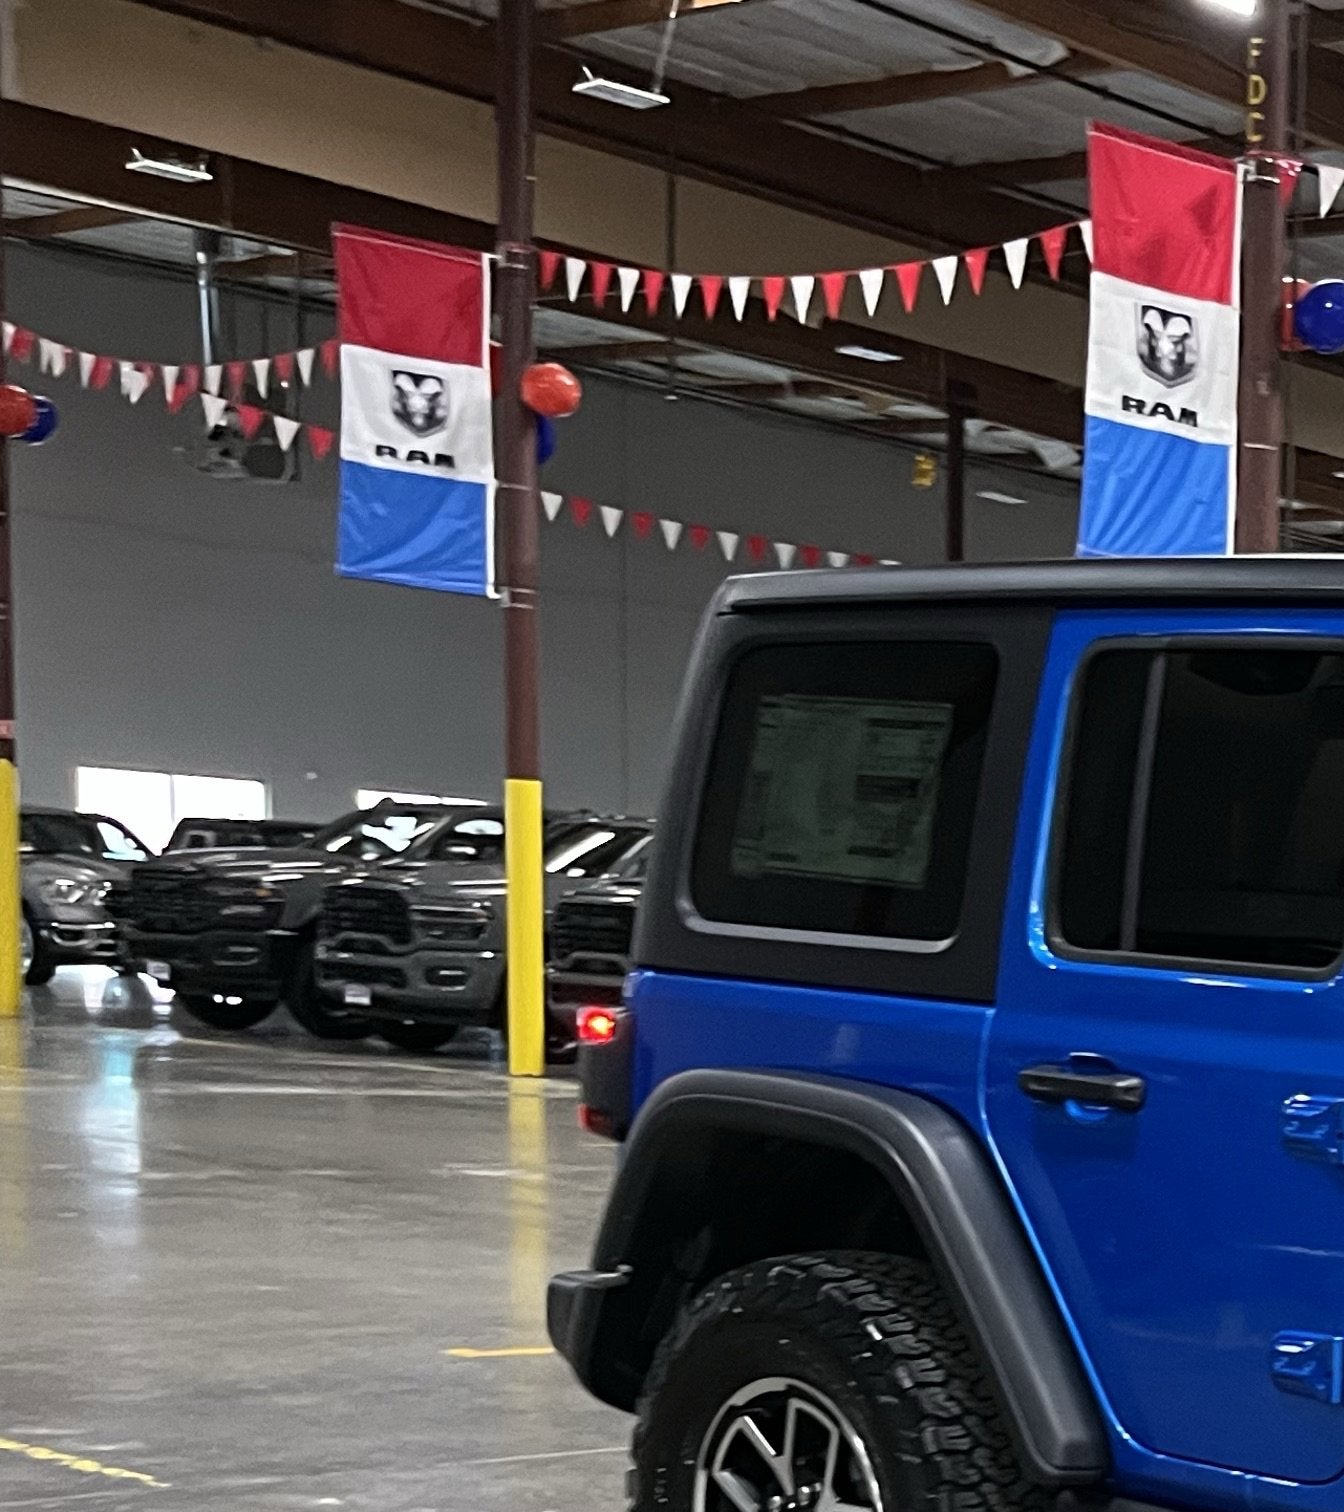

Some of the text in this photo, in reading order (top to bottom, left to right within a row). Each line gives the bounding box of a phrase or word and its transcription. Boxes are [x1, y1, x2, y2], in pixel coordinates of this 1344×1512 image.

[1246, 37, 1267, 142] FDC
[1121, 394, 1198, 427] RAM
[375, 444, 455, 468] RAM
